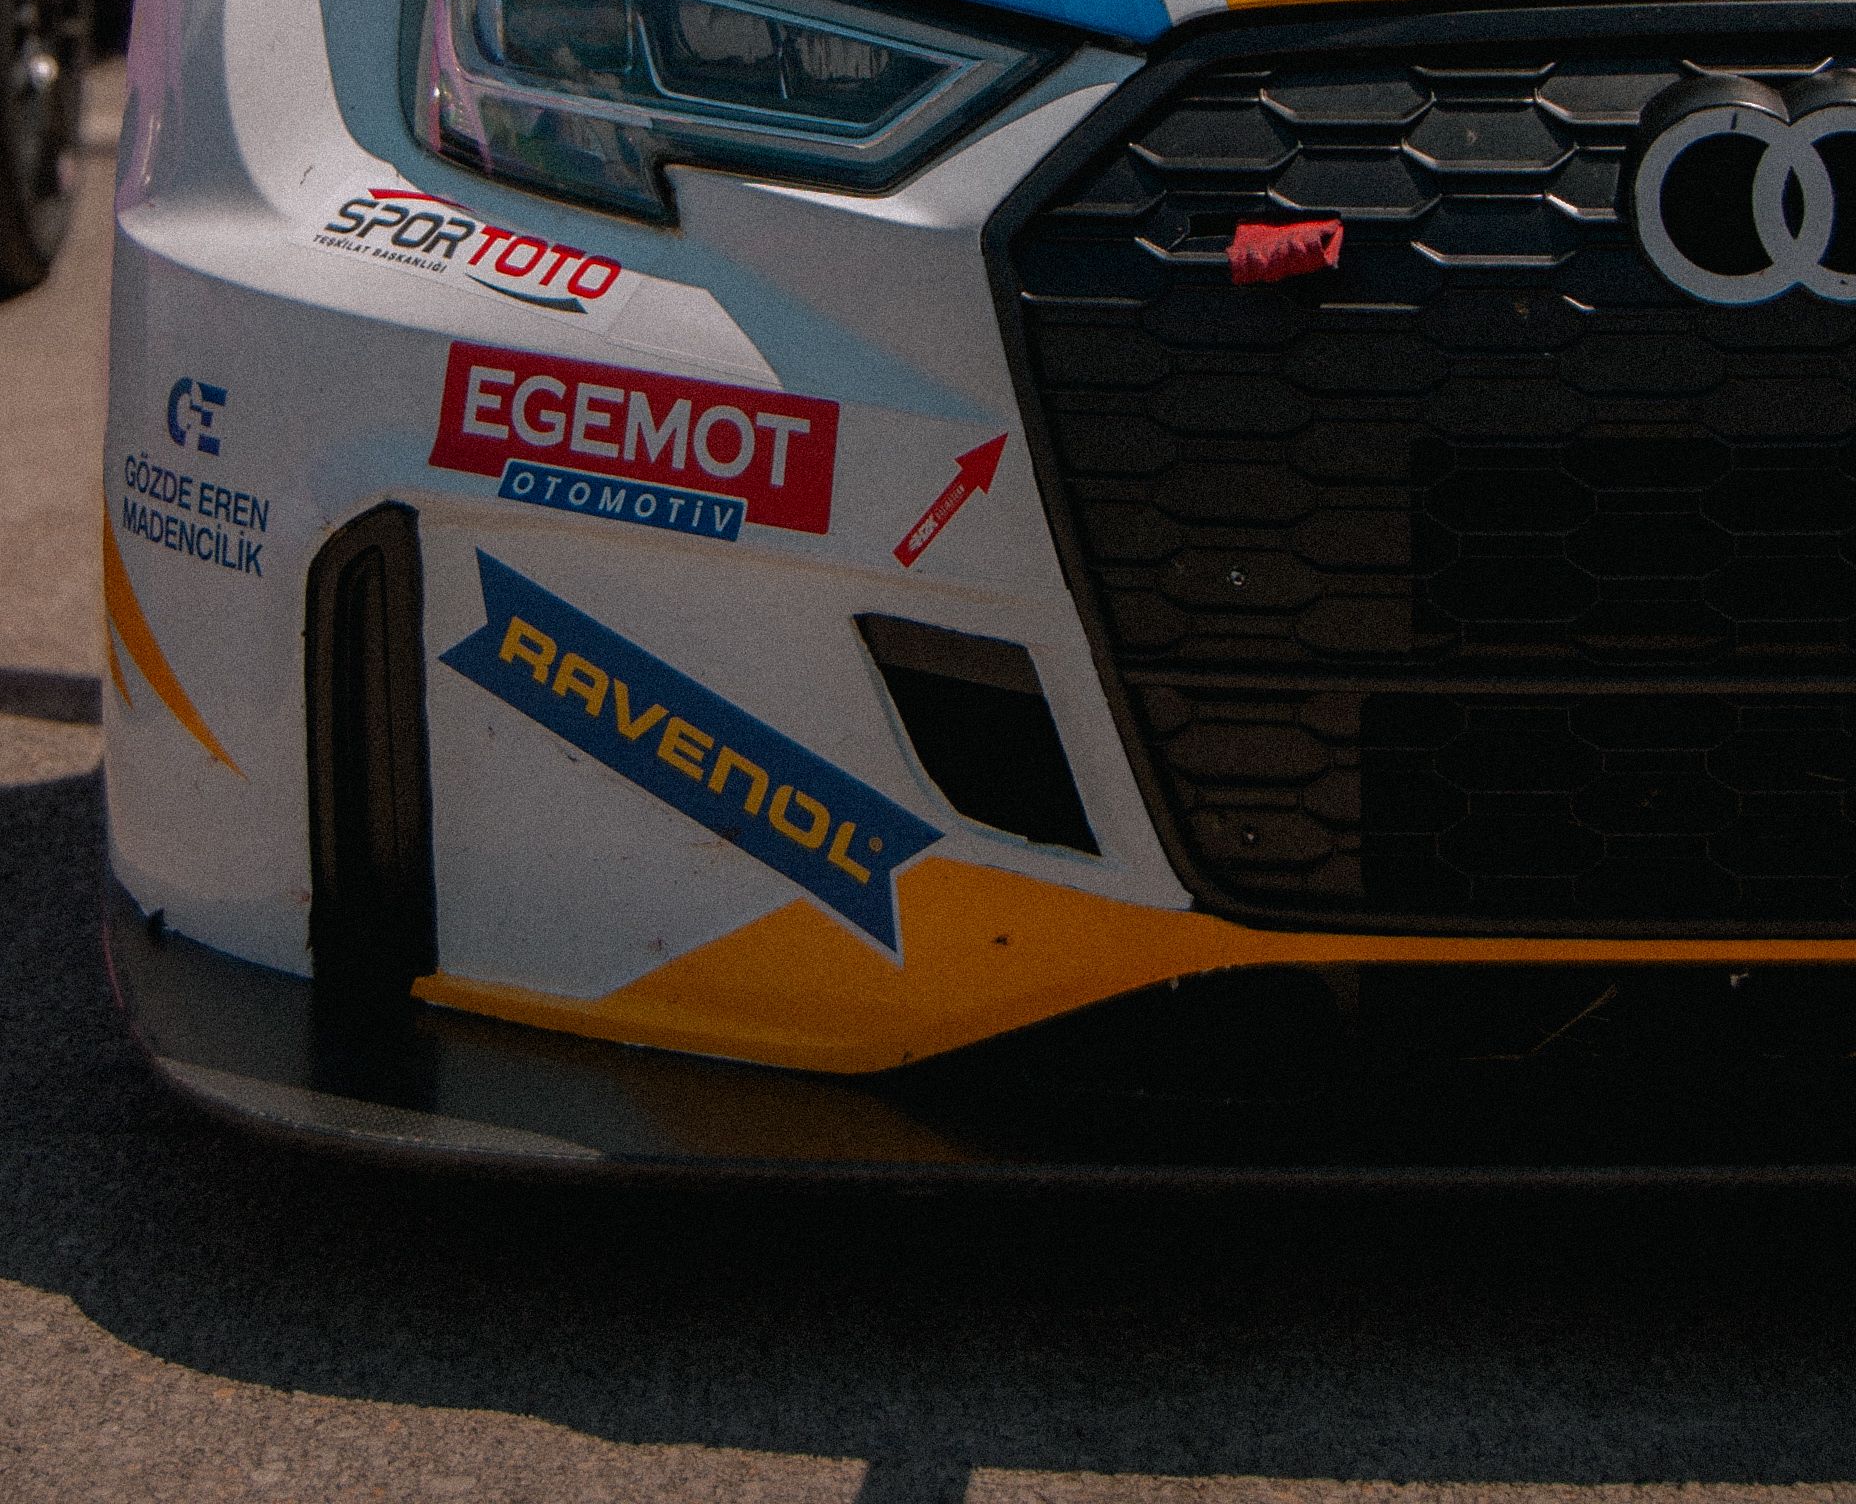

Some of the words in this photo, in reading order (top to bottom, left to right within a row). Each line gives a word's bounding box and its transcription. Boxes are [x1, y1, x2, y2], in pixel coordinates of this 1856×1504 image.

[461, 364, 811, 489] EGEMOT
[123, 451, 194, 511] GÖZDE
[198, 482, 270, 533] EREN
[511, 470, 738, 534] OTOMOTİV
[121, 497, 264, 577] MADENCİLİK
